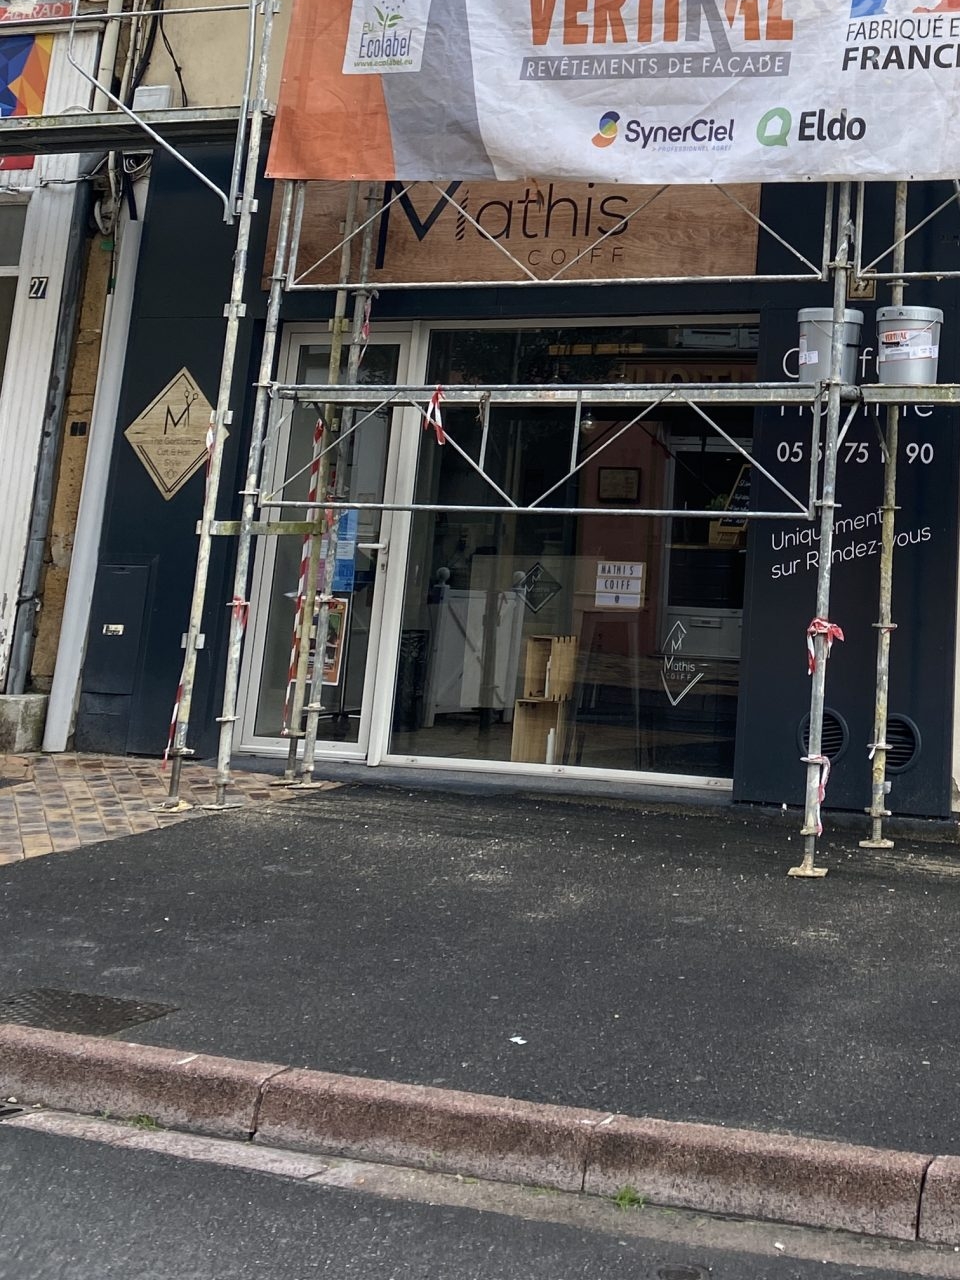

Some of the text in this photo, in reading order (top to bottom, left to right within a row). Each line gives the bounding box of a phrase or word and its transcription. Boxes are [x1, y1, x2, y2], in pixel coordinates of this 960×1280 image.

[363, 22, 375, 32] EU
[846, 15, 944, 42] FABRIQUÉ
[359, 30, 412, 58] Ecolabel
[354, 58, 413, 67] www.ecolabel.eu
[526, 54, 785, 78] REVÊTEMENTS DE FAÇADE
[624, 118, 735, 149] SynerCiel
[798, 108, 867, 141] Eldo
[375, 181, 630, 269] Mathis
[527, 246, 625, 266] COIFF
[30, 278, 48, 297] 27
[776, 441, 803, 462] 05
[844, 442, 869, 463] 75
[906, 442, 934, 464] 90
[771, 508, 884, 551] Uniqument
[771, 526, 932, 579] sur Rndez-vous
[601, 565, 634, 575] MATHIS
[604, 579, 631, 590] COIFF
[664, 655, 696, 672] Mathis
